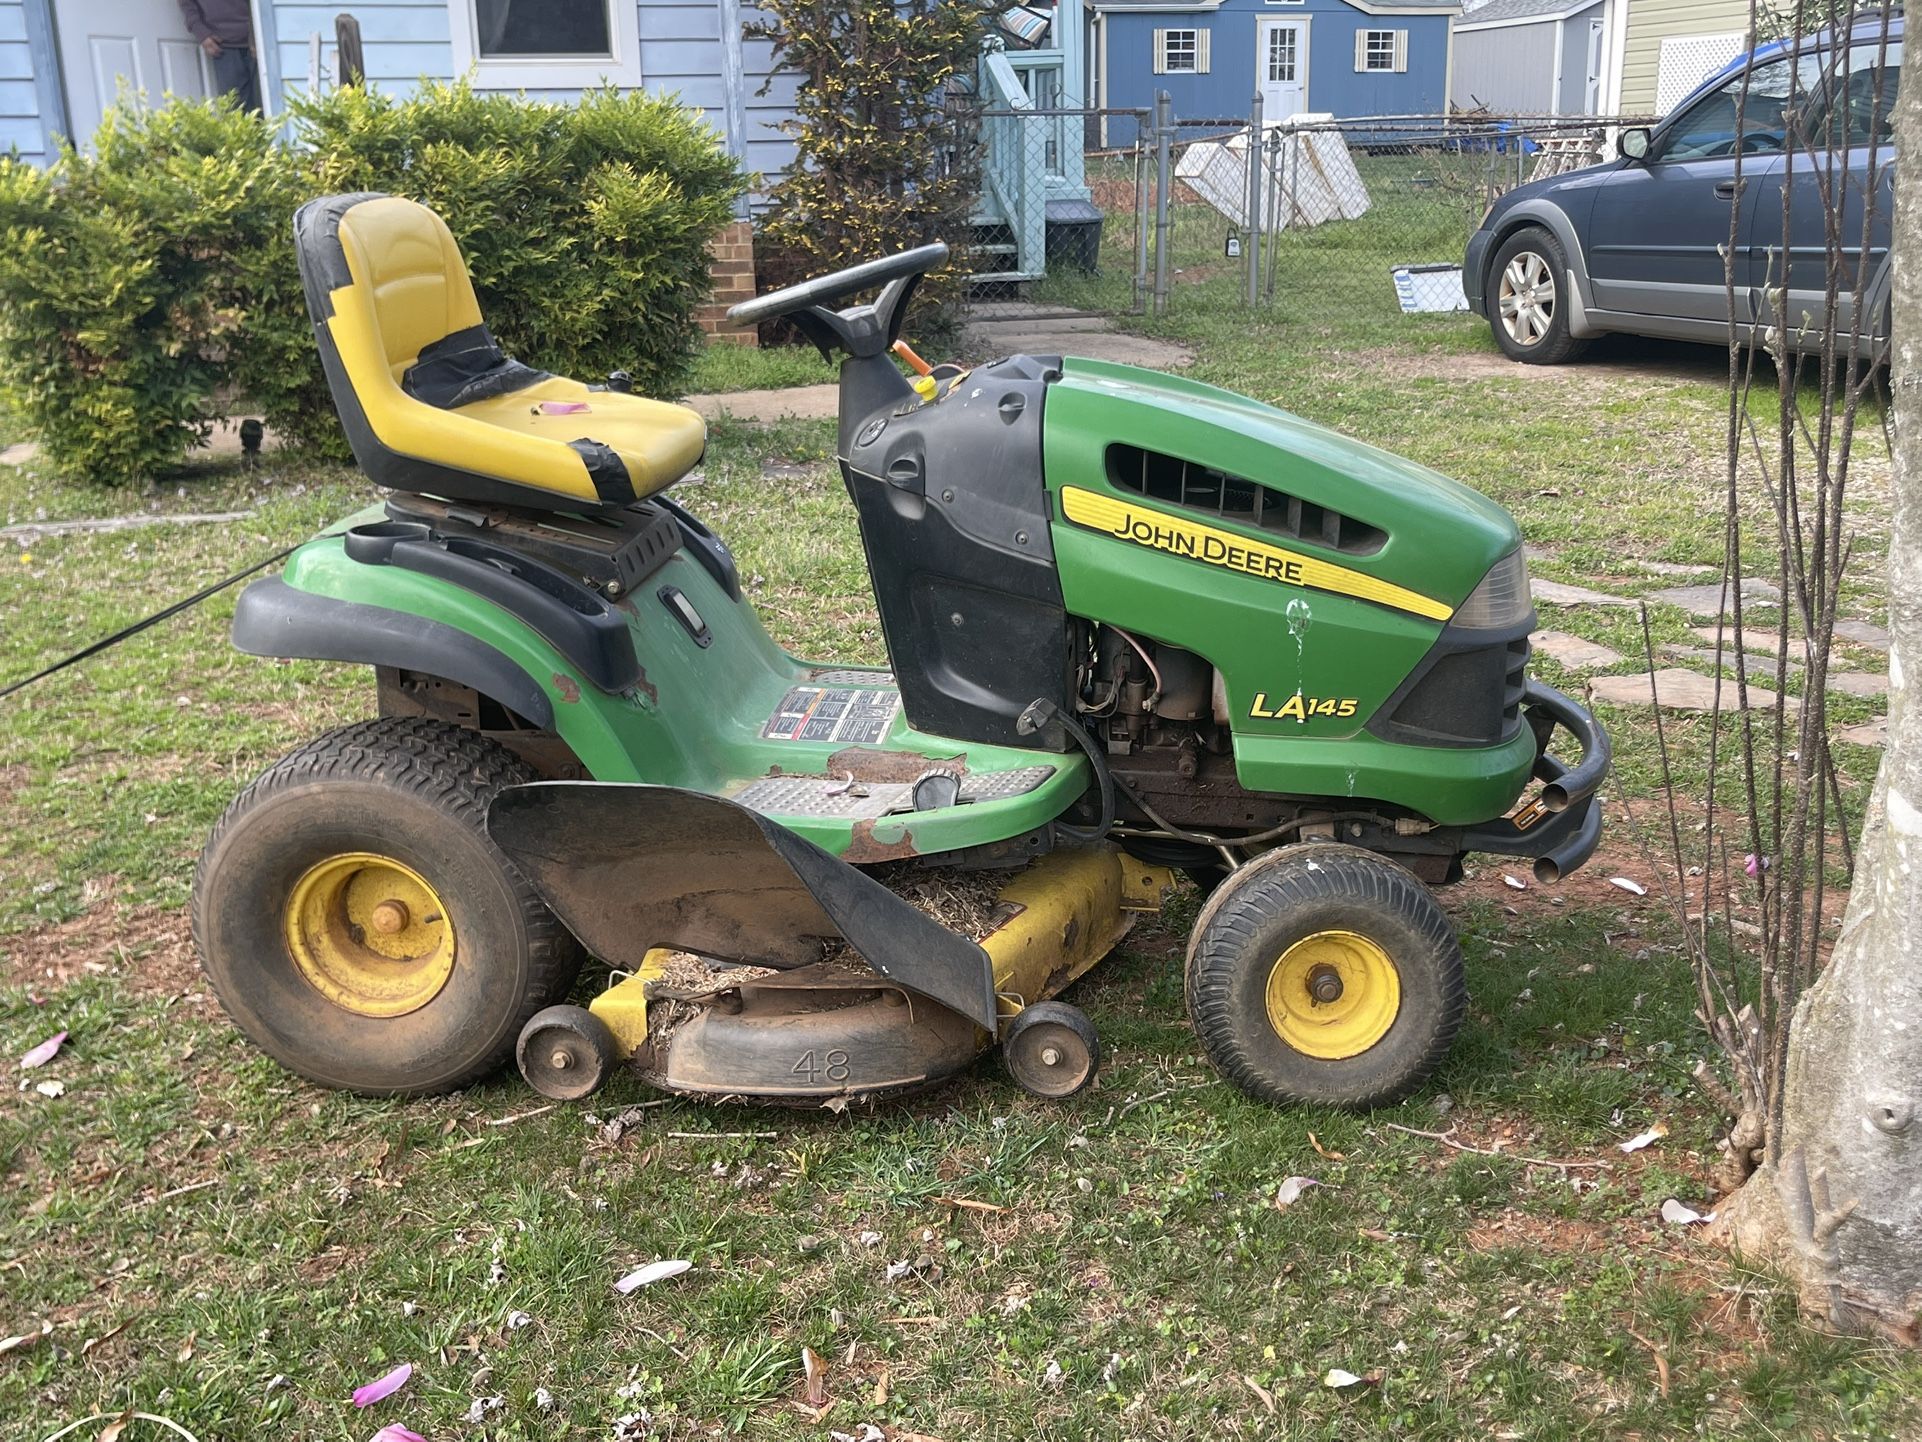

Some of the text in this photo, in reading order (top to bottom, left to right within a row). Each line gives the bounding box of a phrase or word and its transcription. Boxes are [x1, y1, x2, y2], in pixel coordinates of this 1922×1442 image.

[1114, 514, 1303, 582] JOHN DEERE
[1249, 693, 1359, 721] LA145
[791, 1048, 851, 1084] 48
